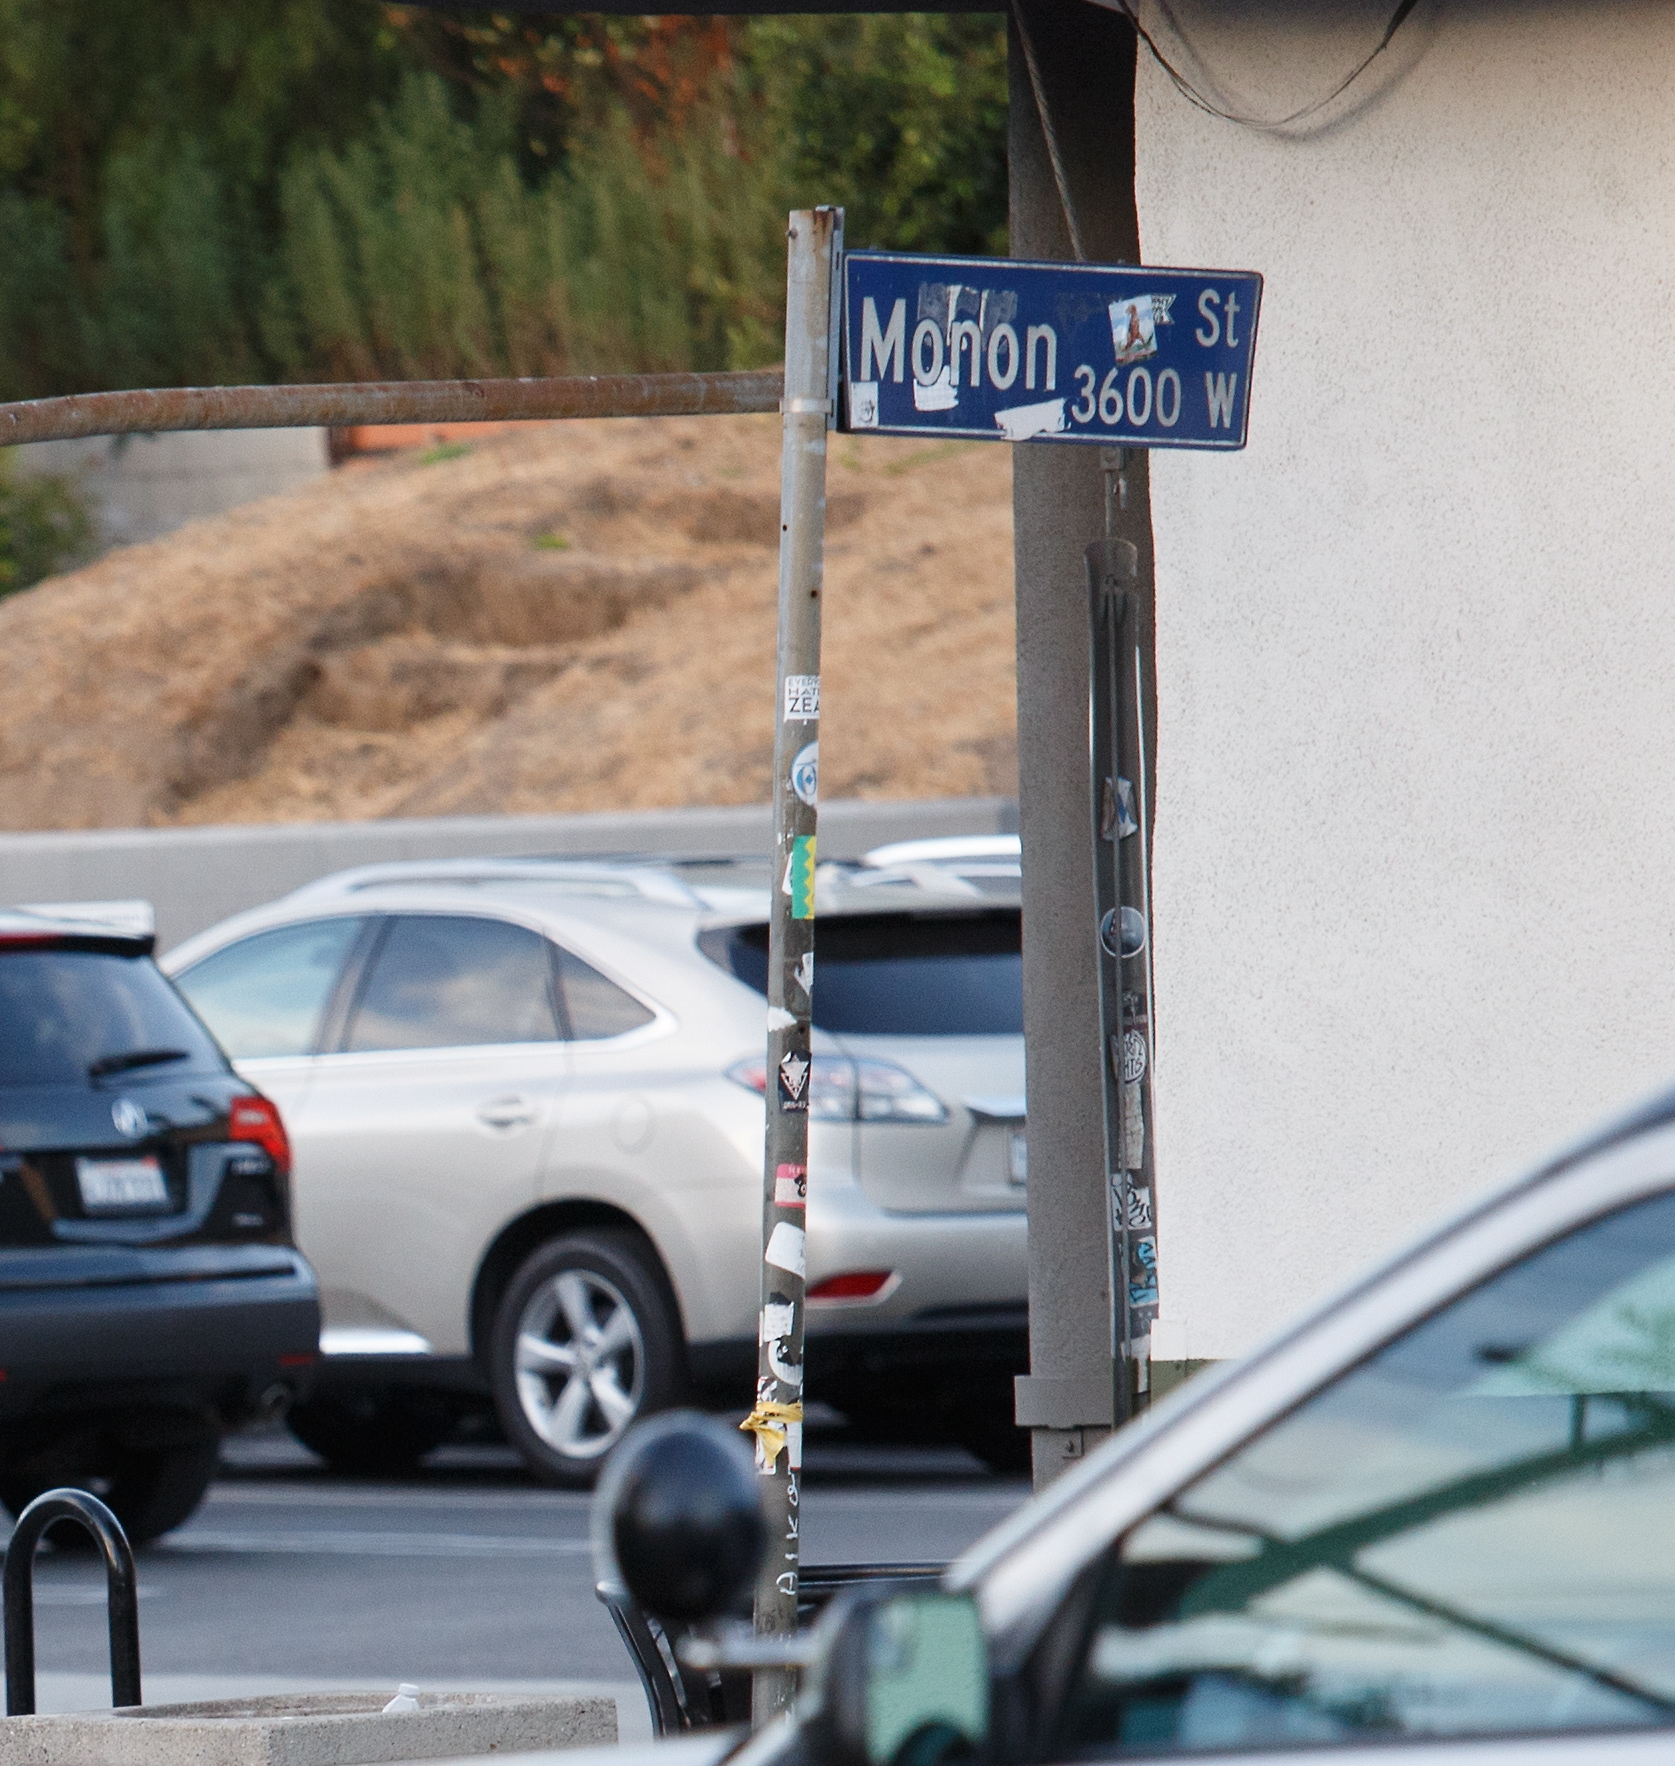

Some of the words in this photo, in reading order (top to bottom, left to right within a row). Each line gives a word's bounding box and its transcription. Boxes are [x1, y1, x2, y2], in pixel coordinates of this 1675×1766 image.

[860, 296, 1058, 392] Monon
[1195, 289, 1241, 349] St
[1071, 364, 1181, 428] 3600
[1205, 371, 1237, 429] W
